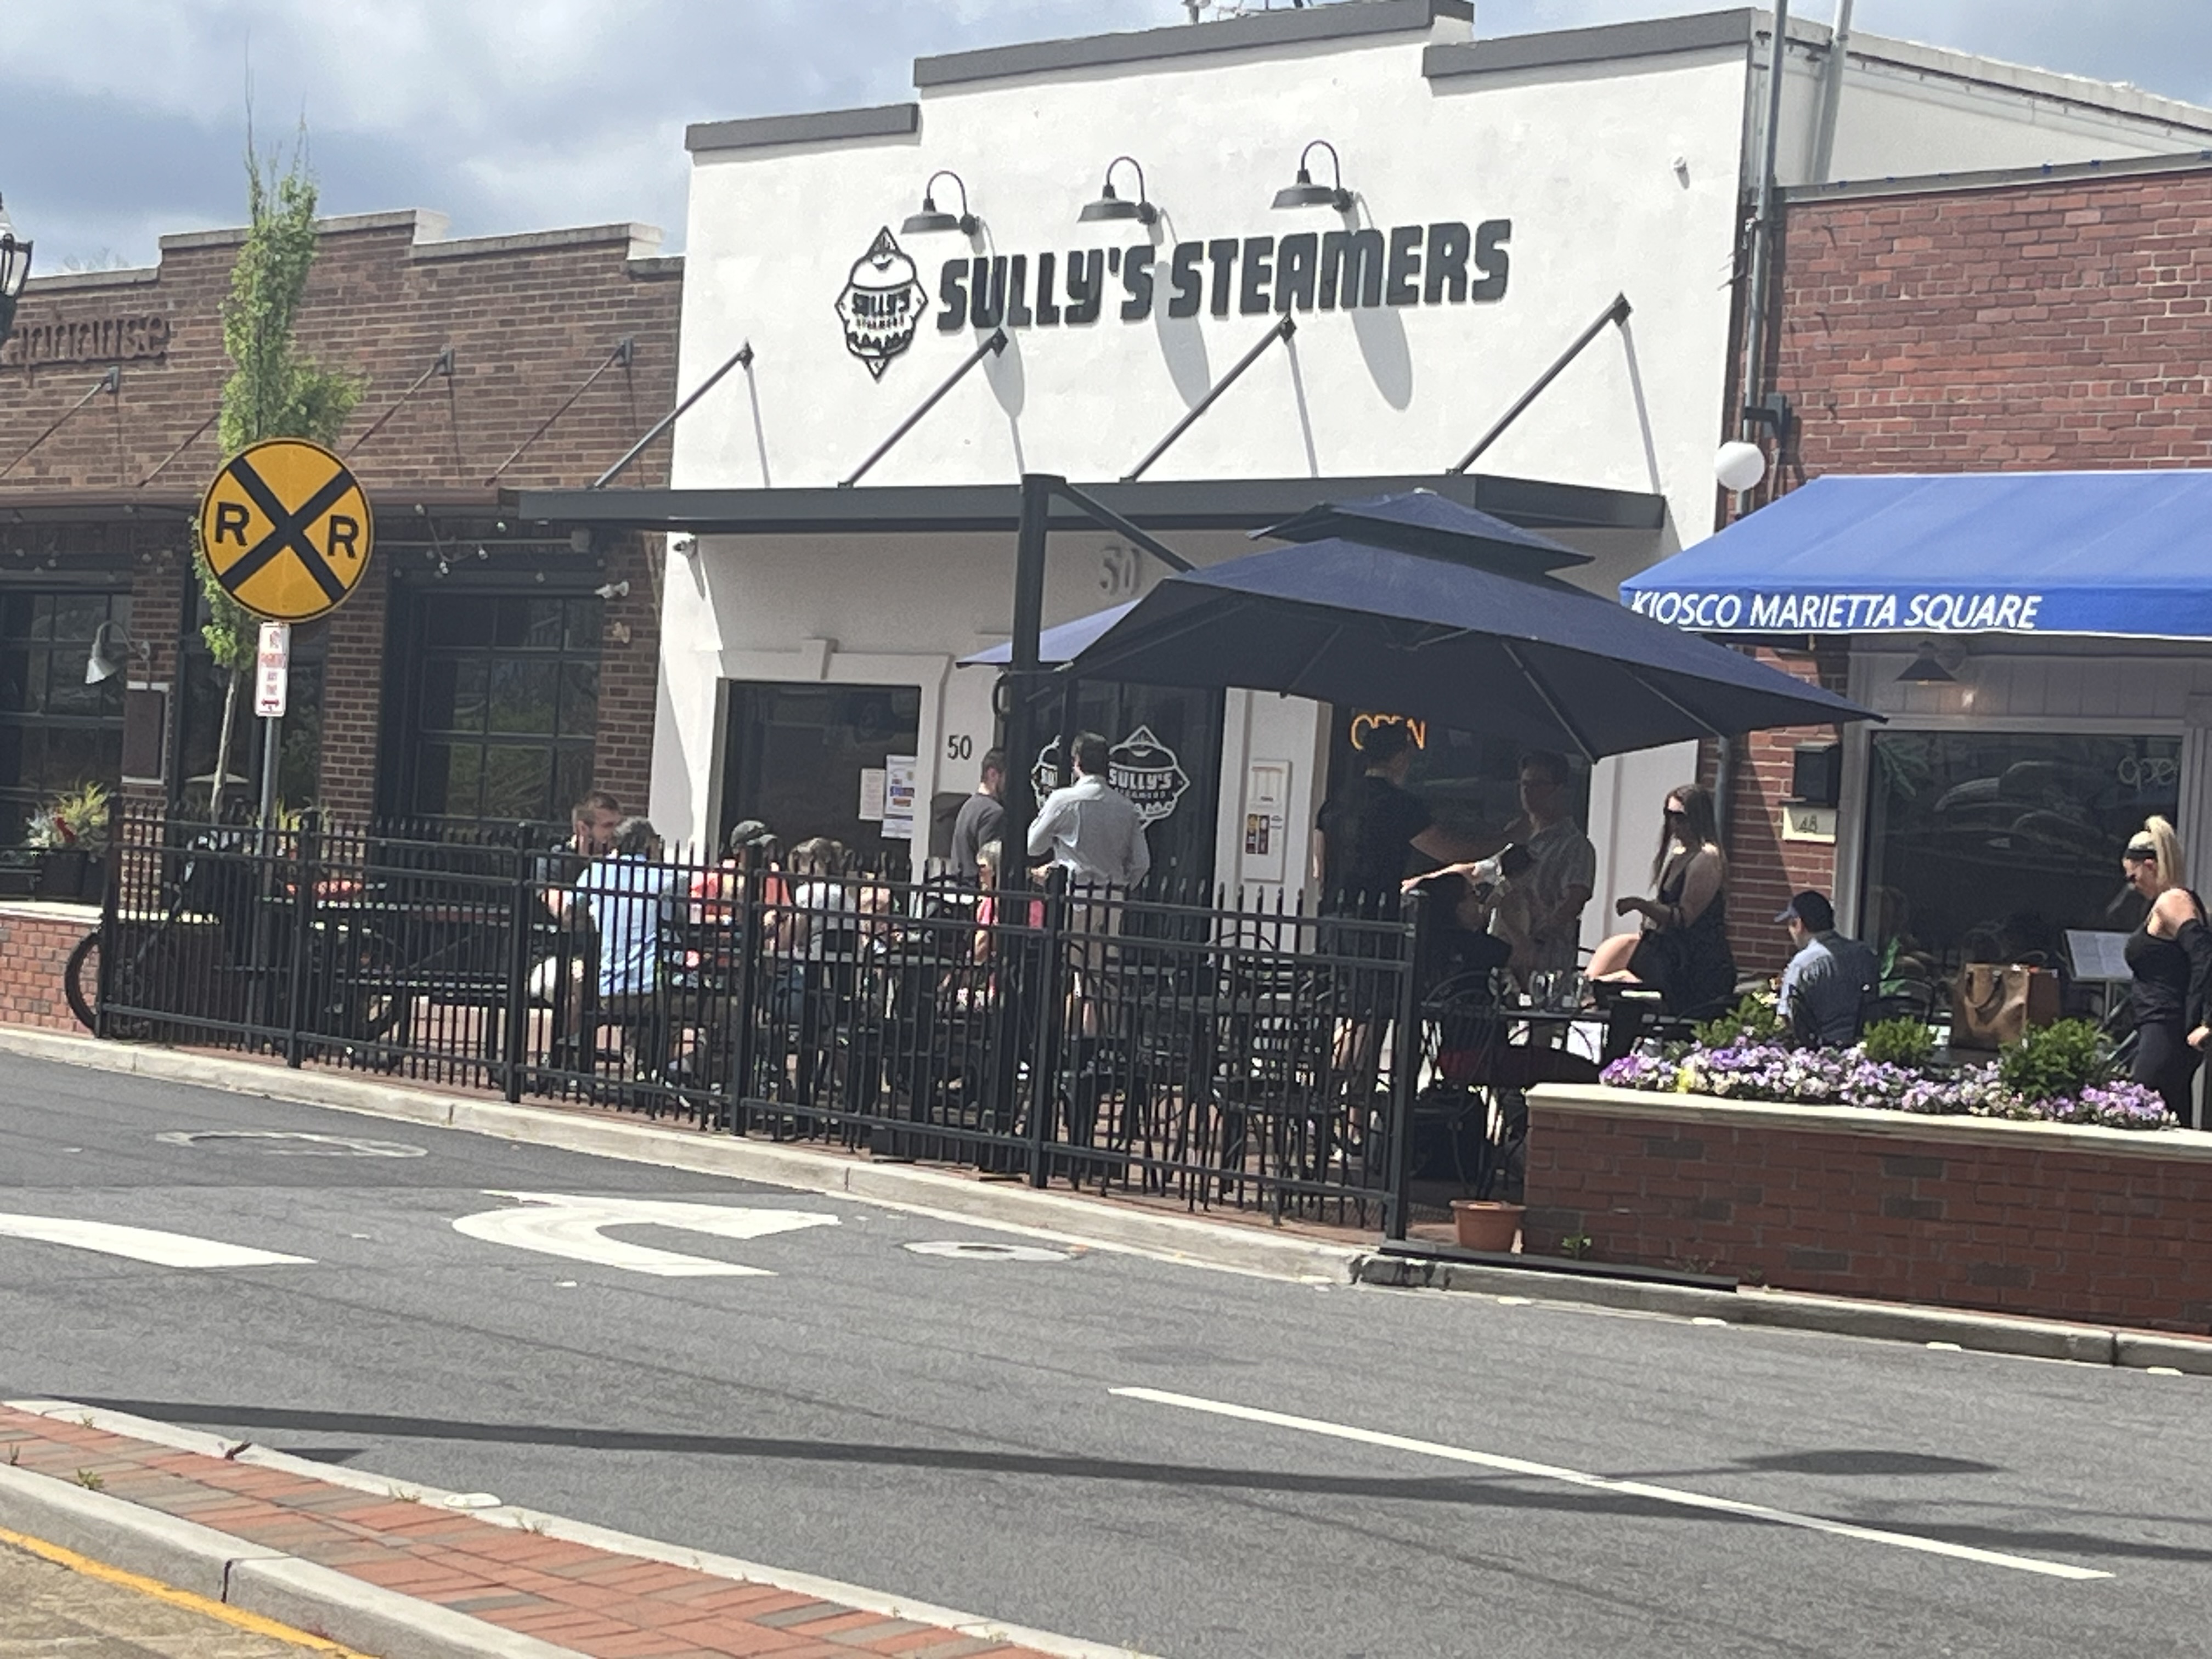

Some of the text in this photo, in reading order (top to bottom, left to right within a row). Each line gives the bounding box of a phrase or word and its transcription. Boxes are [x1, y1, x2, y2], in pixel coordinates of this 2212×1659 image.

[936, 219, 1510, 329] SULLY'S STEAMERS
[215, 501, 359, 558] R R
[1098, 545, 1142, 596] 50
[1631, 590, 2043, 630] KIOSCO MARIETTA SQUARE
[947, 735, 973, 760] 50
[1351, 713, 1426, 751] ON
[1108, 768, 1173, 790] SULLY'S
